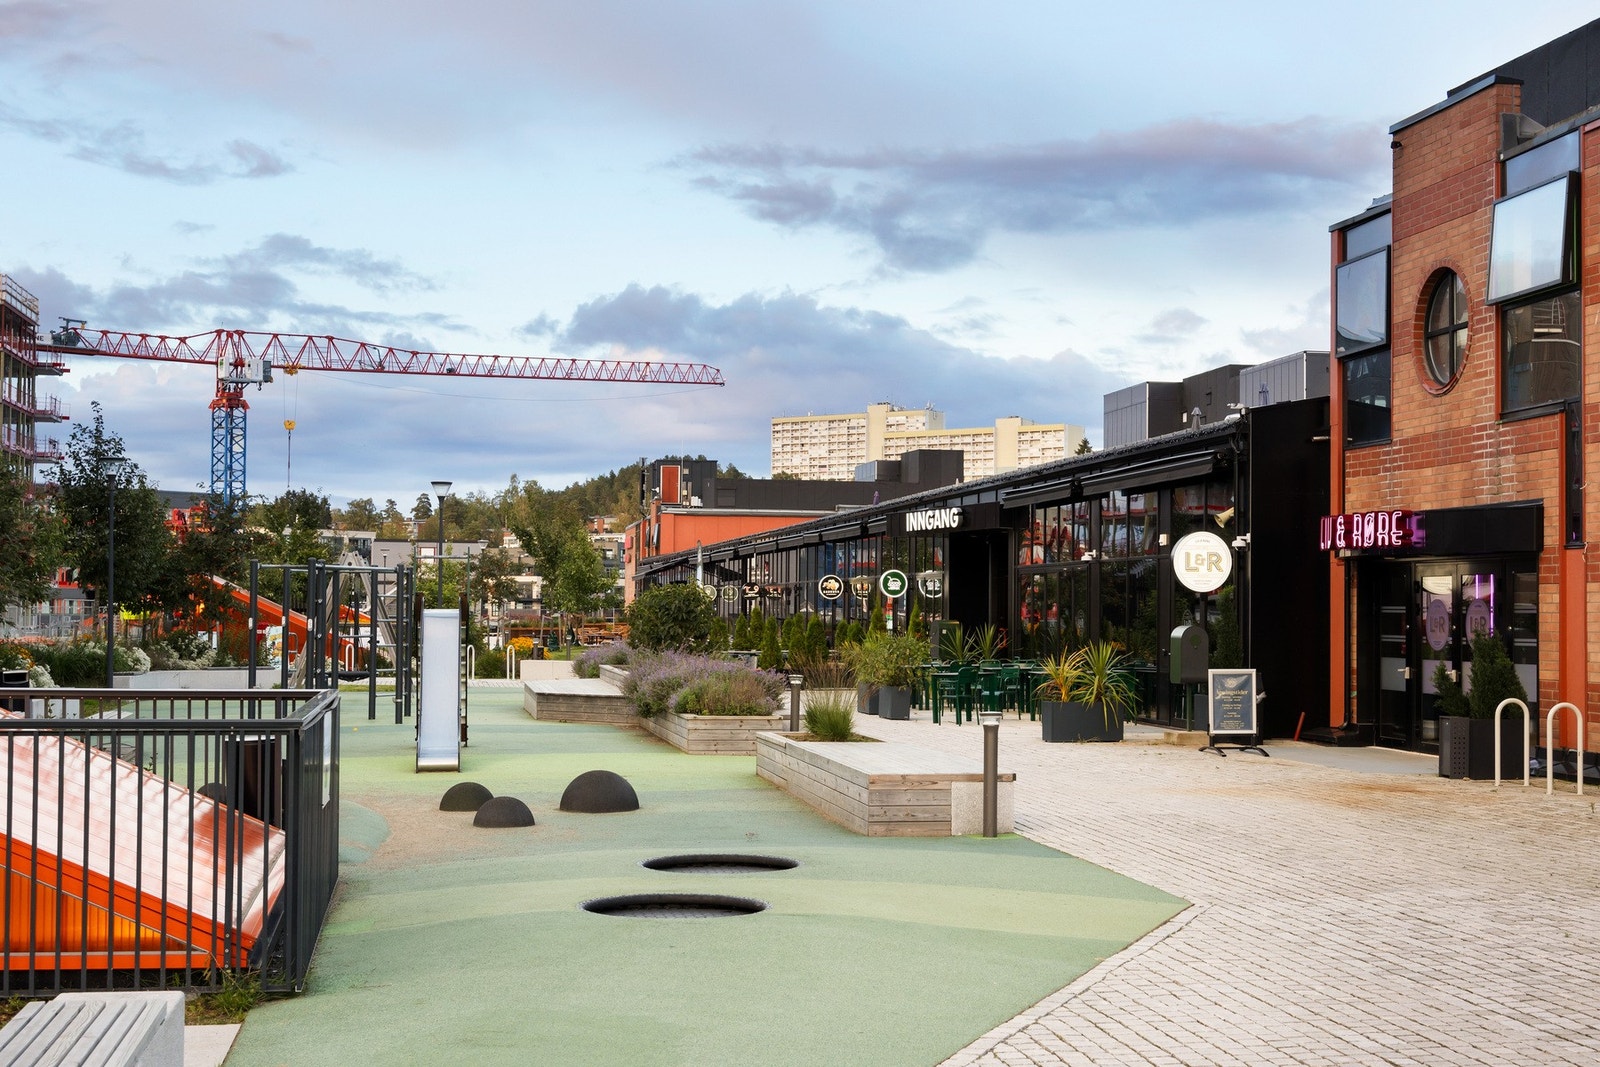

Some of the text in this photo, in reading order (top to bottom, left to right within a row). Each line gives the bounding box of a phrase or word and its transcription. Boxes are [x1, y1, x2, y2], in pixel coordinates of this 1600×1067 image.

[906, 507, 960, 532] INNGANG
[1185, 551, 1223, 573] L&R
[1429, 615, 1445, 633] L&R
